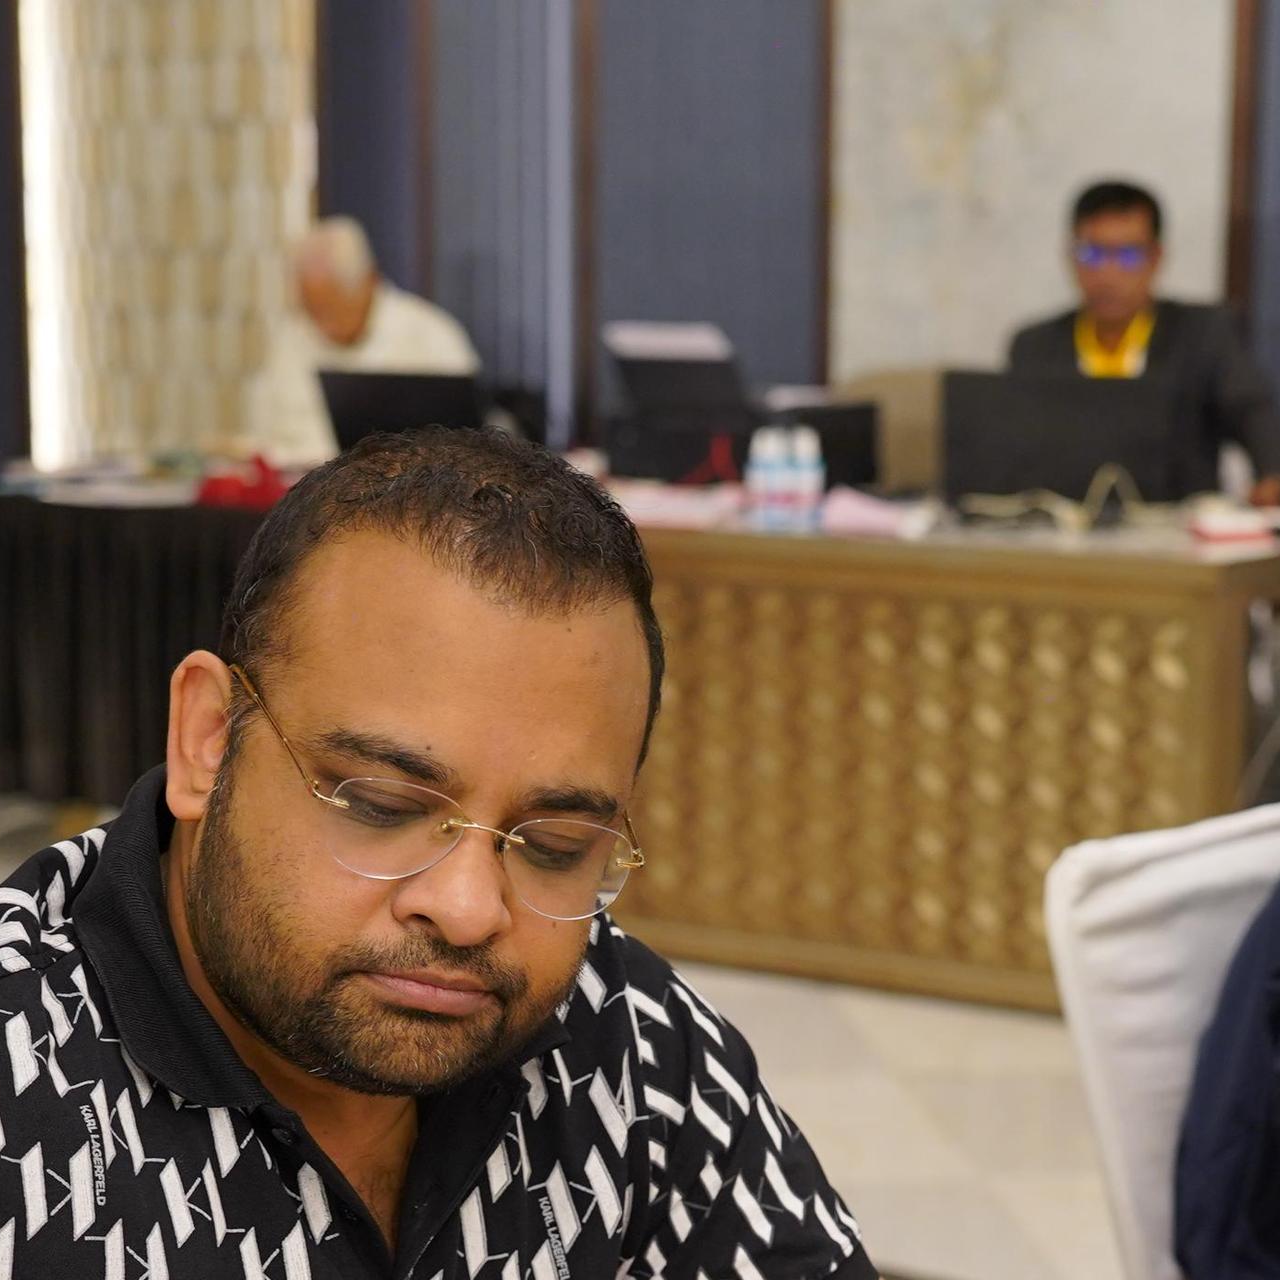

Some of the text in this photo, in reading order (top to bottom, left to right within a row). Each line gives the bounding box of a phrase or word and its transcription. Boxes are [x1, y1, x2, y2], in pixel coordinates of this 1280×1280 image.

[80, 1104, 107, 1207] KARL LAGERFELD
[539, 1196, 555, 1227] KARL
